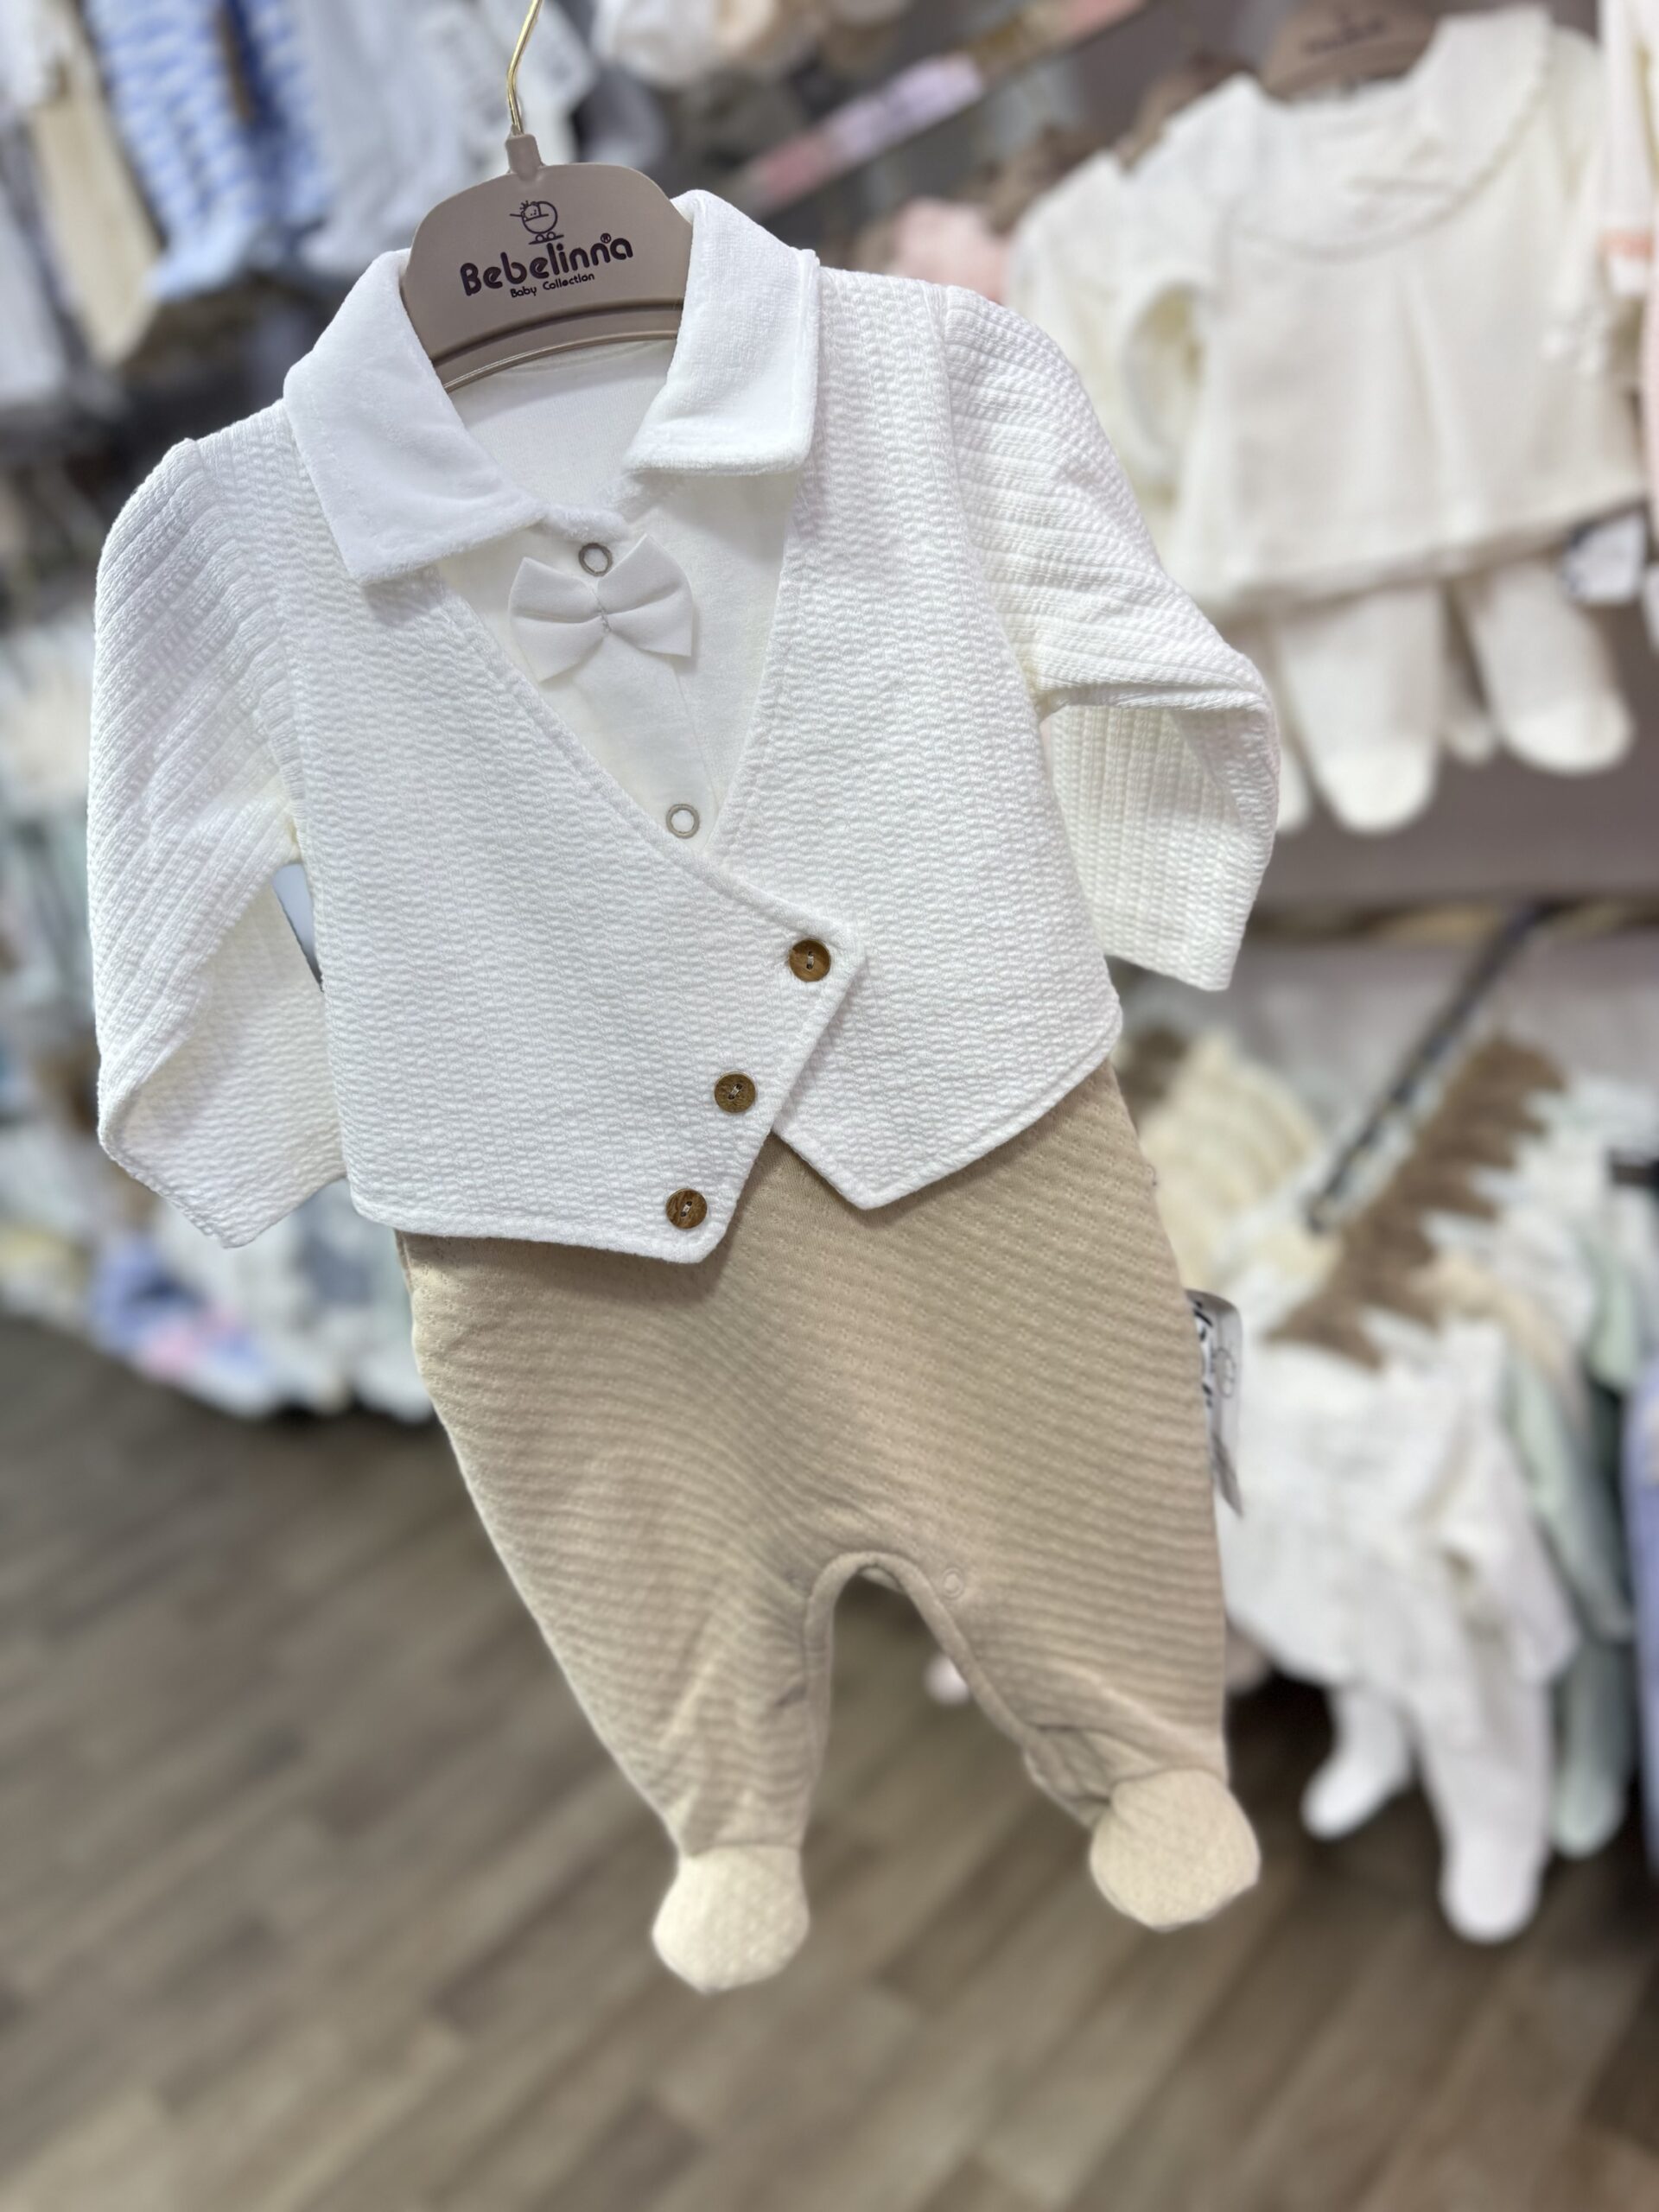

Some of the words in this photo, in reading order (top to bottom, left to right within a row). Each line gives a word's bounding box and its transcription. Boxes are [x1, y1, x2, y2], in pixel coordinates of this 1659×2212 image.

[460, 237, 633, 296] Bebelinna
[510, 286, 537, 298] Baby
[543, 273, 595, 290] Collection
